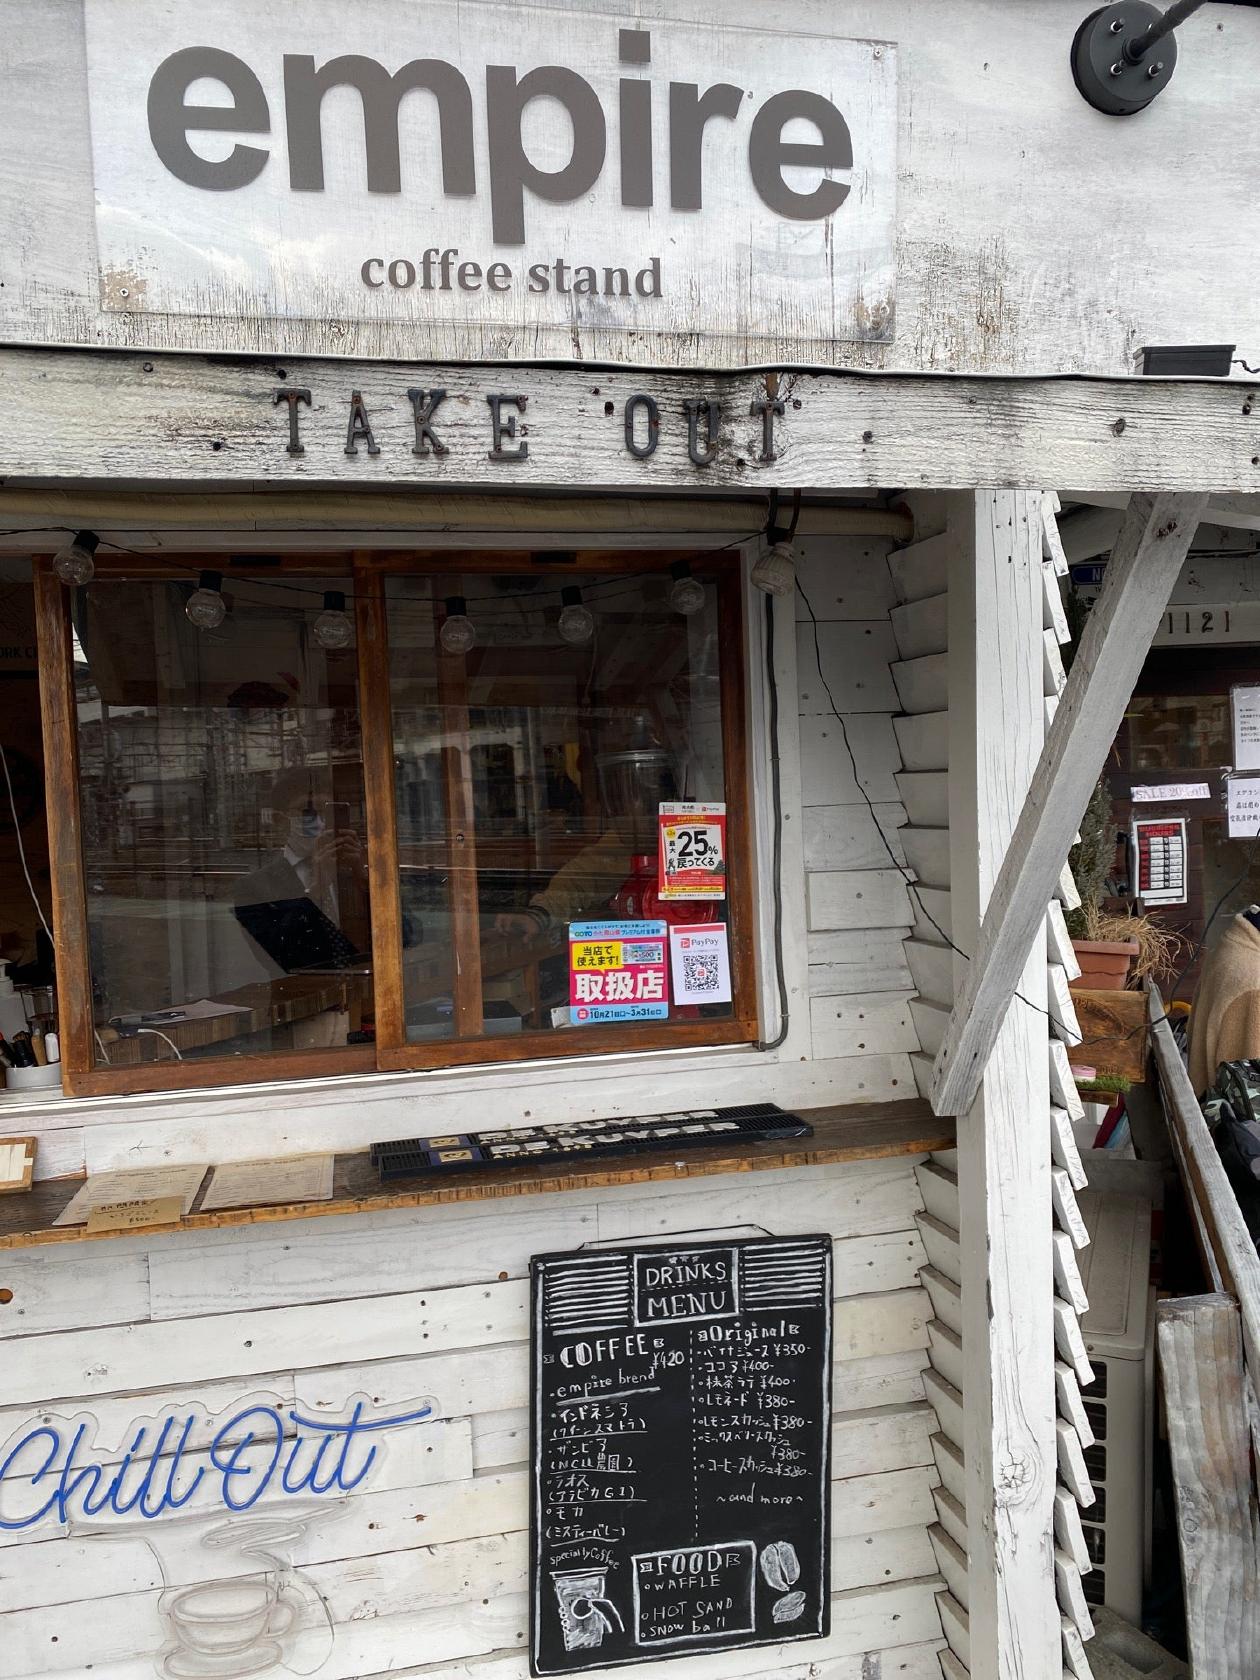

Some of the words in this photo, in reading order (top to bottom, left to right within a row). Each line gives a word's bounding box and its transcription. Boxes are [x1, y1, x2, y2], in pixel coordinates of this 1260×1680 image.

[147, 28, 854, 246] empire
[360, 248, 513, 293] coffee
[528, 257, 663, 299] stand
[274, 387, 529, 459] TAKE
[624, 392, 786, 465] OUT
[678, 830, 719, 858] 25%
[677, 857, 714, 869] 戻ってくる
[583, 945, 613, 956] 当店で
[691, 938, 719, 947] PayPay
[575, 971, 664, 1003] 取扱店
[478, 1128, 536, 1141] DE
[542, 1111, 719, 1134] KUYPER
[490, 1140, 550, 1154] DE
[557, 1122, 740, 1147] KUYPER
[646, 1261, 726, 1286] DRINKS
[646, 1290, 727, 1317] MENU
[709, 1320, 786, 1346] Original
[559, 1333, 649, 1368] COFFEE
[653, 1351, 685, 1369] ¥420
[557, 1375, 612, 1398] empire
[618, 1366, 656, 1385] brend
[0, 1415, 204, 1530] Chill
[211, 1401, 432, 1512] Out
[555, 1474, 589, 1488] ラオス
[556, 1506, 584, 1520] モカ
[656, 1550, 722, 1576] FOOD
[653, 1601, 687, 1621] HOT
[692, 1597, 733, 1619] SAND
